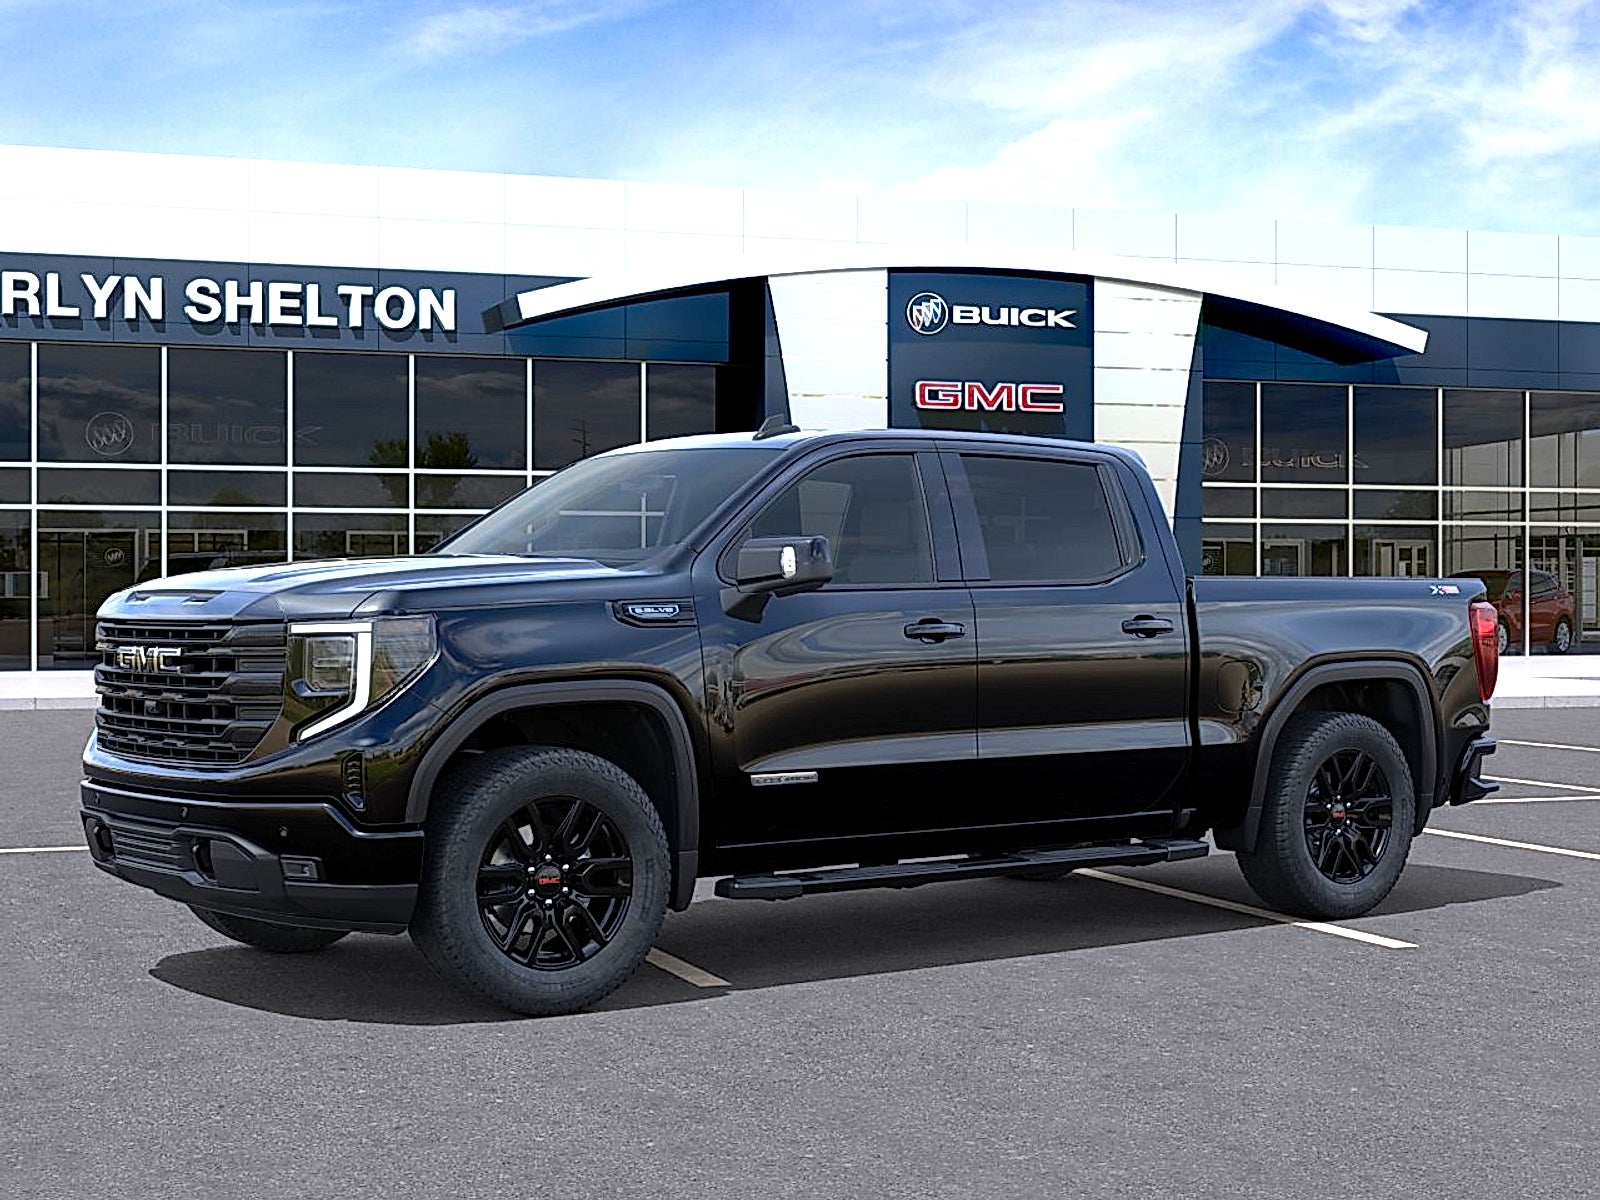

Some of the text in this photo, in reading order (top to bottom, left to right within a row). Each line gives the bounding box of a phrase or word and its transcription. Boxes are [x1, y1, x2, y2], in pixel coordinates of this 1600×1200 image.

[184, 278, 456, 331] SHELTON
[952, 304, 1078, 329] BUICK
[915, 380, 1064, 412] GMC
[117, 645, 182, 674] GMC
